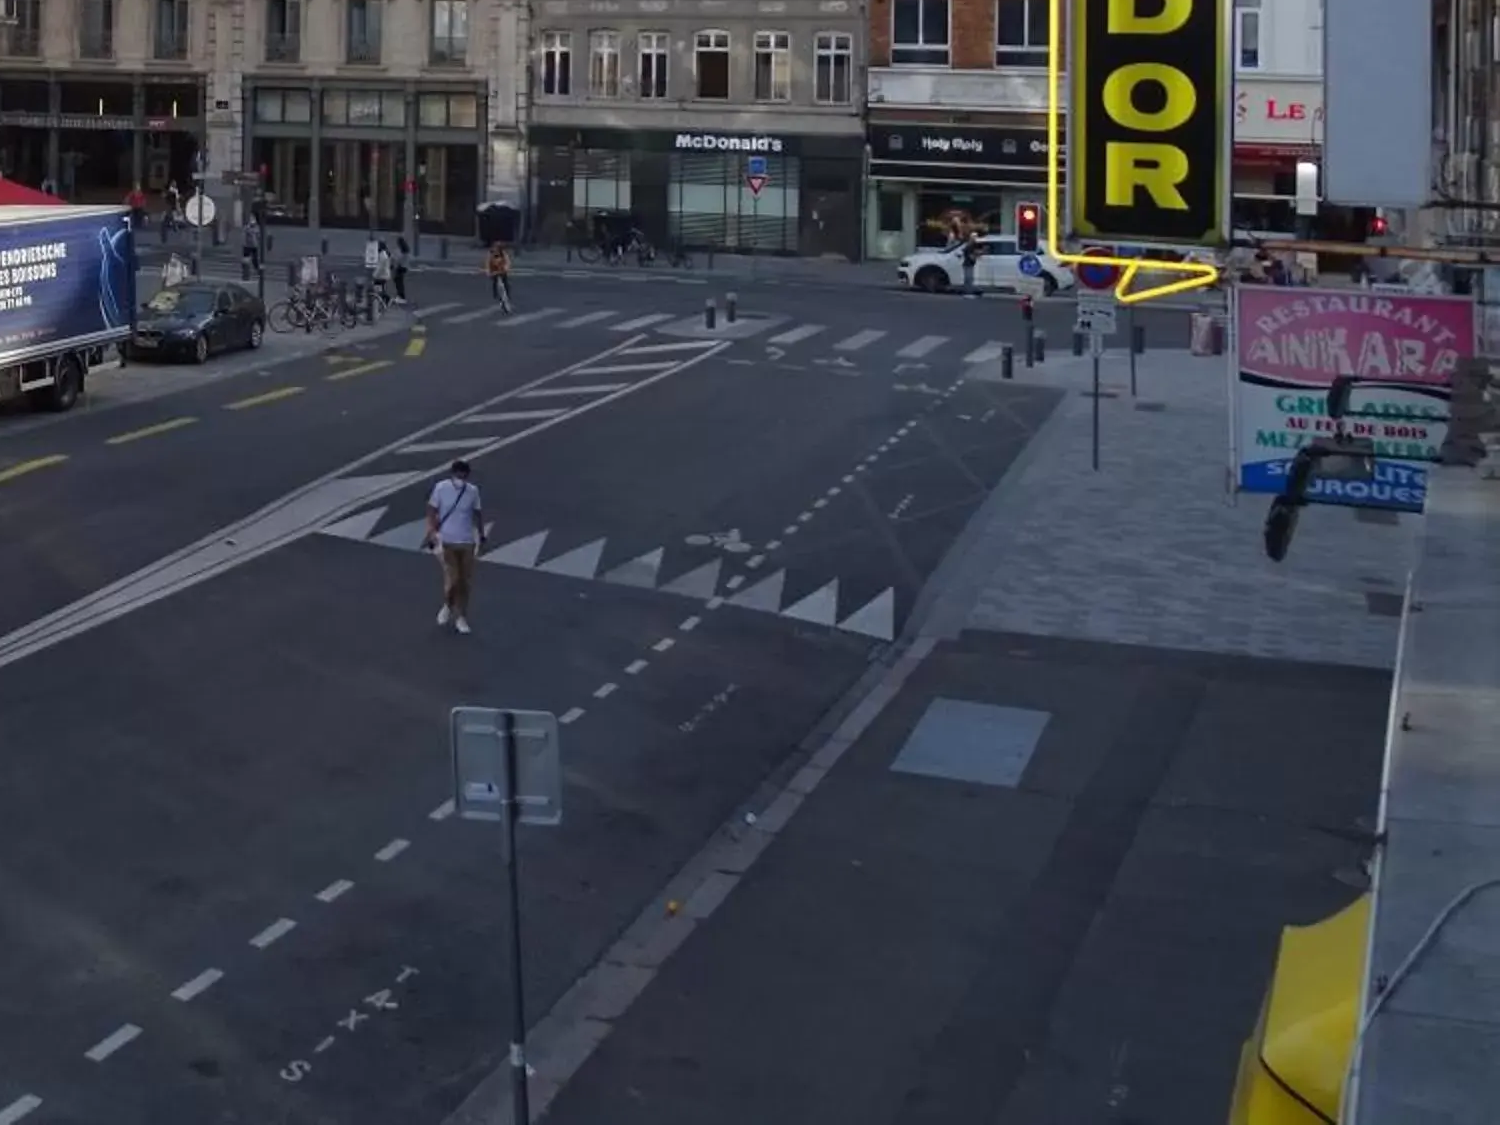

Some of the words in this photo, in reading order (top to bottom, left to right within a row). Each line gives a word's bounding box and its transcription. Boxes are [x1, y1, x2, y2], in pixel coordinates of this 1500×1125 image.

[675, 134, 783, 152] McDonald's
[12, 263, 57, 284] BOISSONS
[1255, 295, 1456, 344] RESTAURANT
[1247, 327, 1460, 376] ANKARA
[1276, 395, 1439, 422] GRIADES
[1285, 416, 1307, 429] AU
[1353, 422, 1375, 435] DE
[1384, 425, 1428, 439] BOIS
